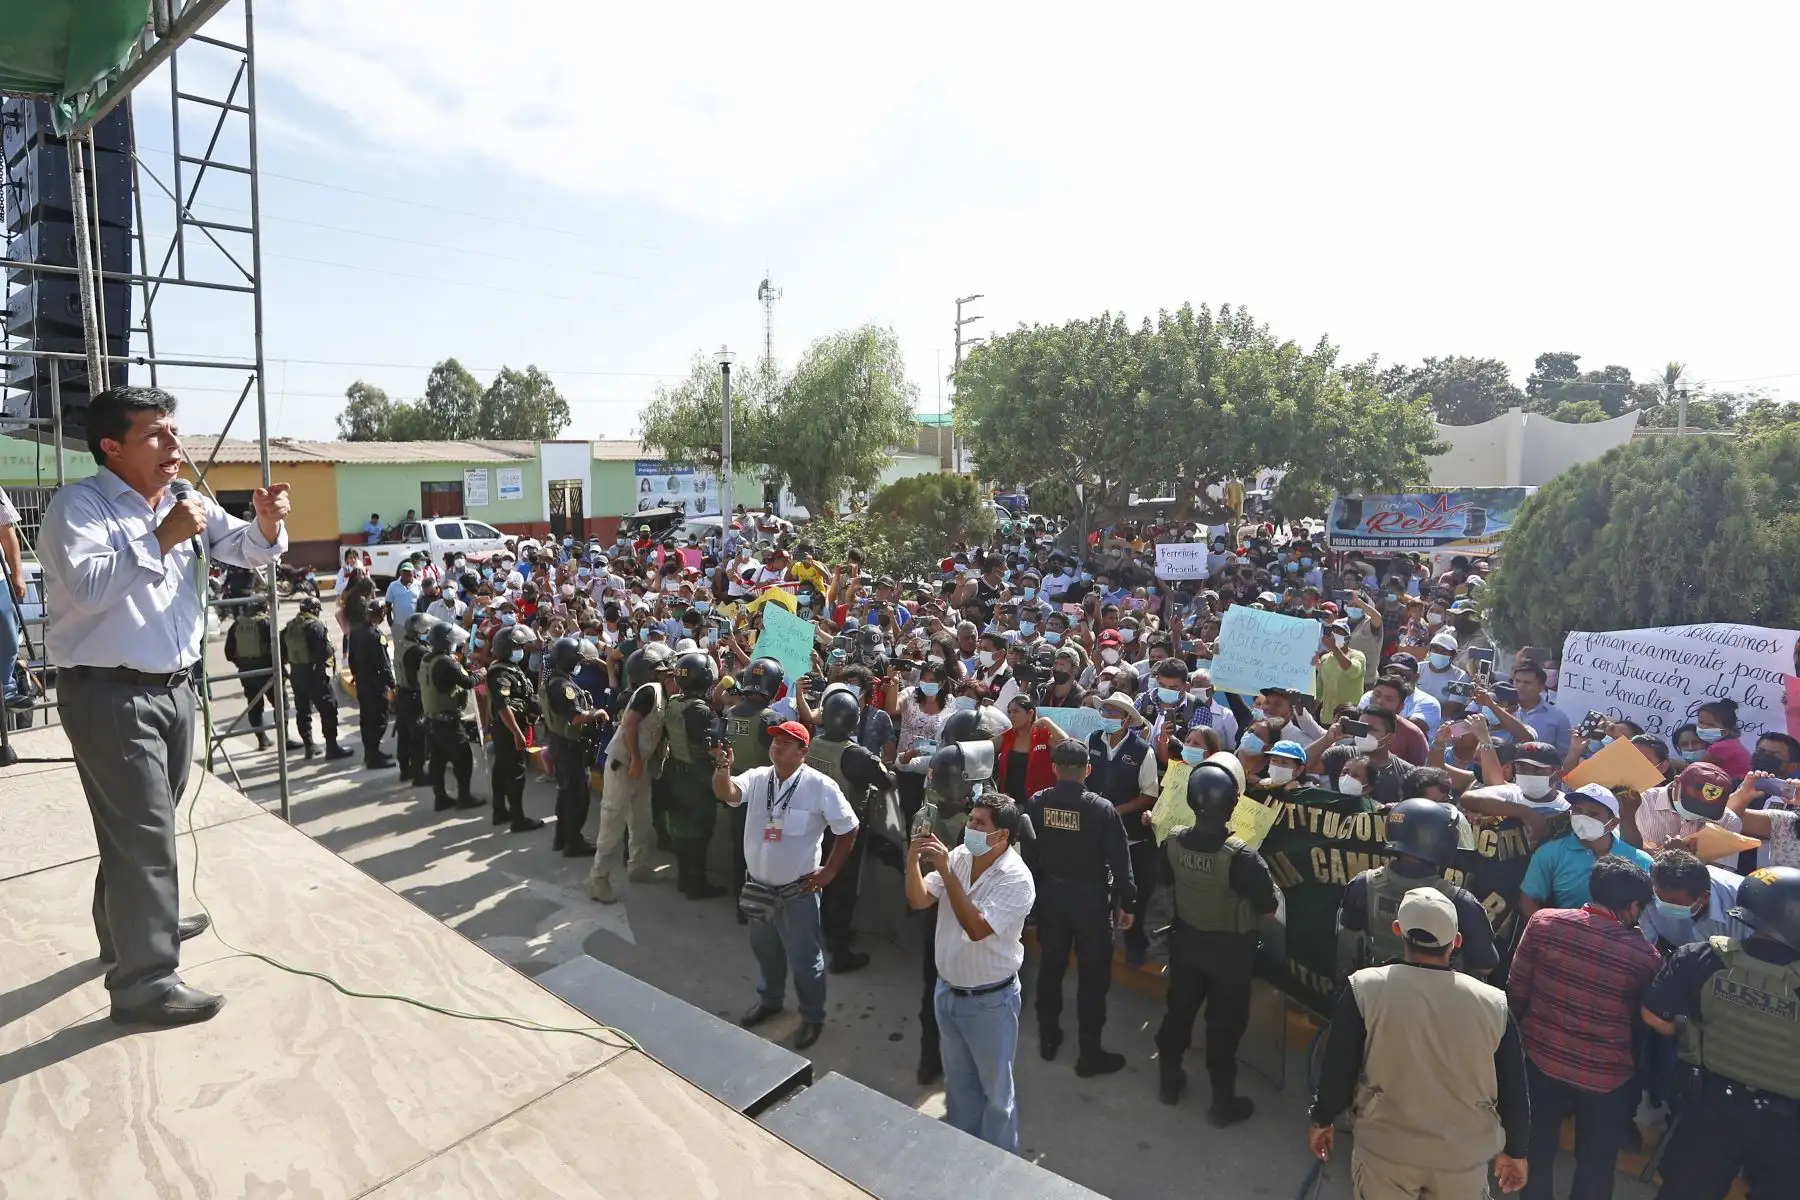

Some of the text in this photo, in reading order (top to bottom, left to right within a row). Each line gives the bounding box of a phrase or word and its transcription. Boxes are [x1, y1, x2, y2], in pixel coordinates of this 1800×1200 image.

[1365, 511, 1461, 535] Rey
[1399, 538, 1418, 546] PITIPO
[1419, 538, 1434, 546] PERU
[1165, 563, 1199, 574] Presente
[1677, 623, 1784, 654] solicitamos
[1585, 631, 1726, 671] financiamiento
[1727, 661, 1785, 687] para
[1564, 641, 1769, 710] la construcción de la
[1045, 809, 1078, 829] POLICIA
[1179, 851, 1213, 874] POLICIA
